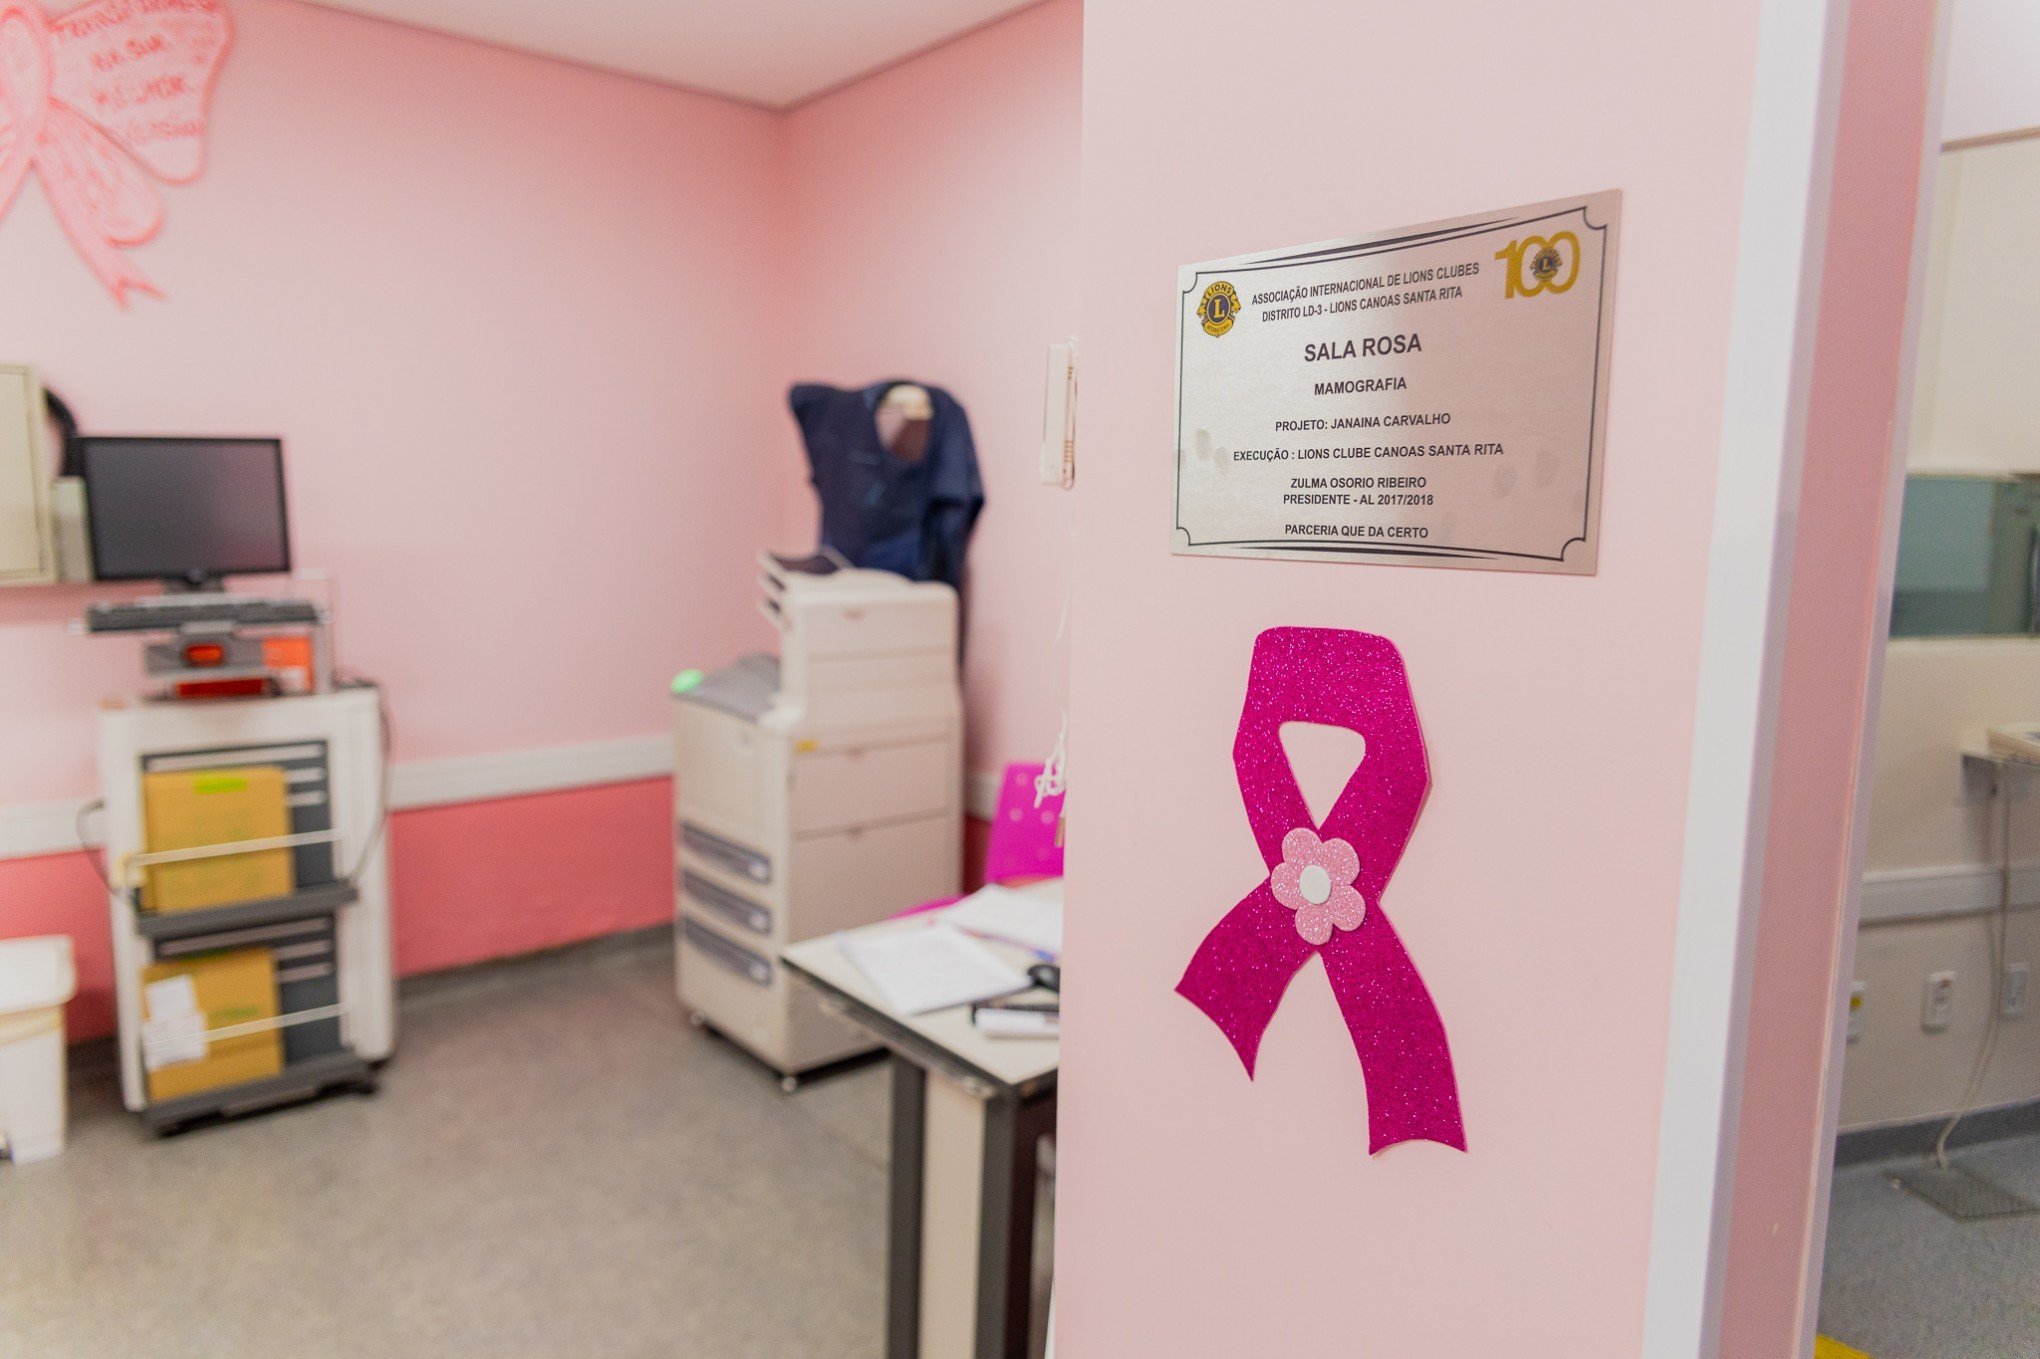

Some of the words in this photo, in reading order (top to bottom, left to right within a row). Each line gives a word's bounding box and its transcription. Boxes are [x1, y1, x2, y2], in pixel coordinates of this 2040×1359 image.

[1493, 230, 1581, 299] 100
[1206, 283, 1232, 297] LIONS
[1251, 285, 1309, 306] ASSOCIAÇÃO
[1309, 275, 1386, 298] INTERNACIONAL
[1386, 273, 1402, 288] DE
[1402, 268, 1434, 285] LIONS
[1435, 262, 1480, 280] CLUBES
[1213, 298, 1225, 319] L
[1262, 306, 1302, 323] DISTRITO
[1302, 303, 1323, 318] LD-3
[1329, 298, 1358, 315] LIONS
[1359, 293, 1401, 311] CANOAS
[1402, 289, 1437, 305] SANTA
[1438, 285, 1463, 300] RITA
[1304, 339, 1357, 363] SALA
[1361, 332, 1423, 358] ROSA
[1314, 376, 1408, 396] MAMOGRAFIA
[1275, 418, 1328, 432] PROJETO:
[1330, 416, 1382, 430] JANAINA
[1382, 412, 1451, 427] CARVALHO
[1233, 447, 1290, 463] EXECUÇÃO
[1297, 448, 1331, 460] LIONS
[1332, 446, 1372, 460] CLUBE
[1373, 445, 1426, 458] CANOAS
[1427, 443, 1471, 457] SANTA
[1473, 442, 1505, 456] RITA
[1290, 477, 1328, 489] ZULMA
[1329, 476, 1375, 489] OSORIO
[1376, 476, 1427, 489] RIBEIRO
[1283, 493, 1351, 505] PRESIDENTE
[1358, 493, 1376, 506] AL
[1376, 493, 1434, 506] 2017/2018
[1284, 523, 1339, 537] PARCERIA
[1340, 525, 1366, 538] QUE
[1367, 525, 1385, 538] DA
[1386, 526, 1429, 539] CERTO
